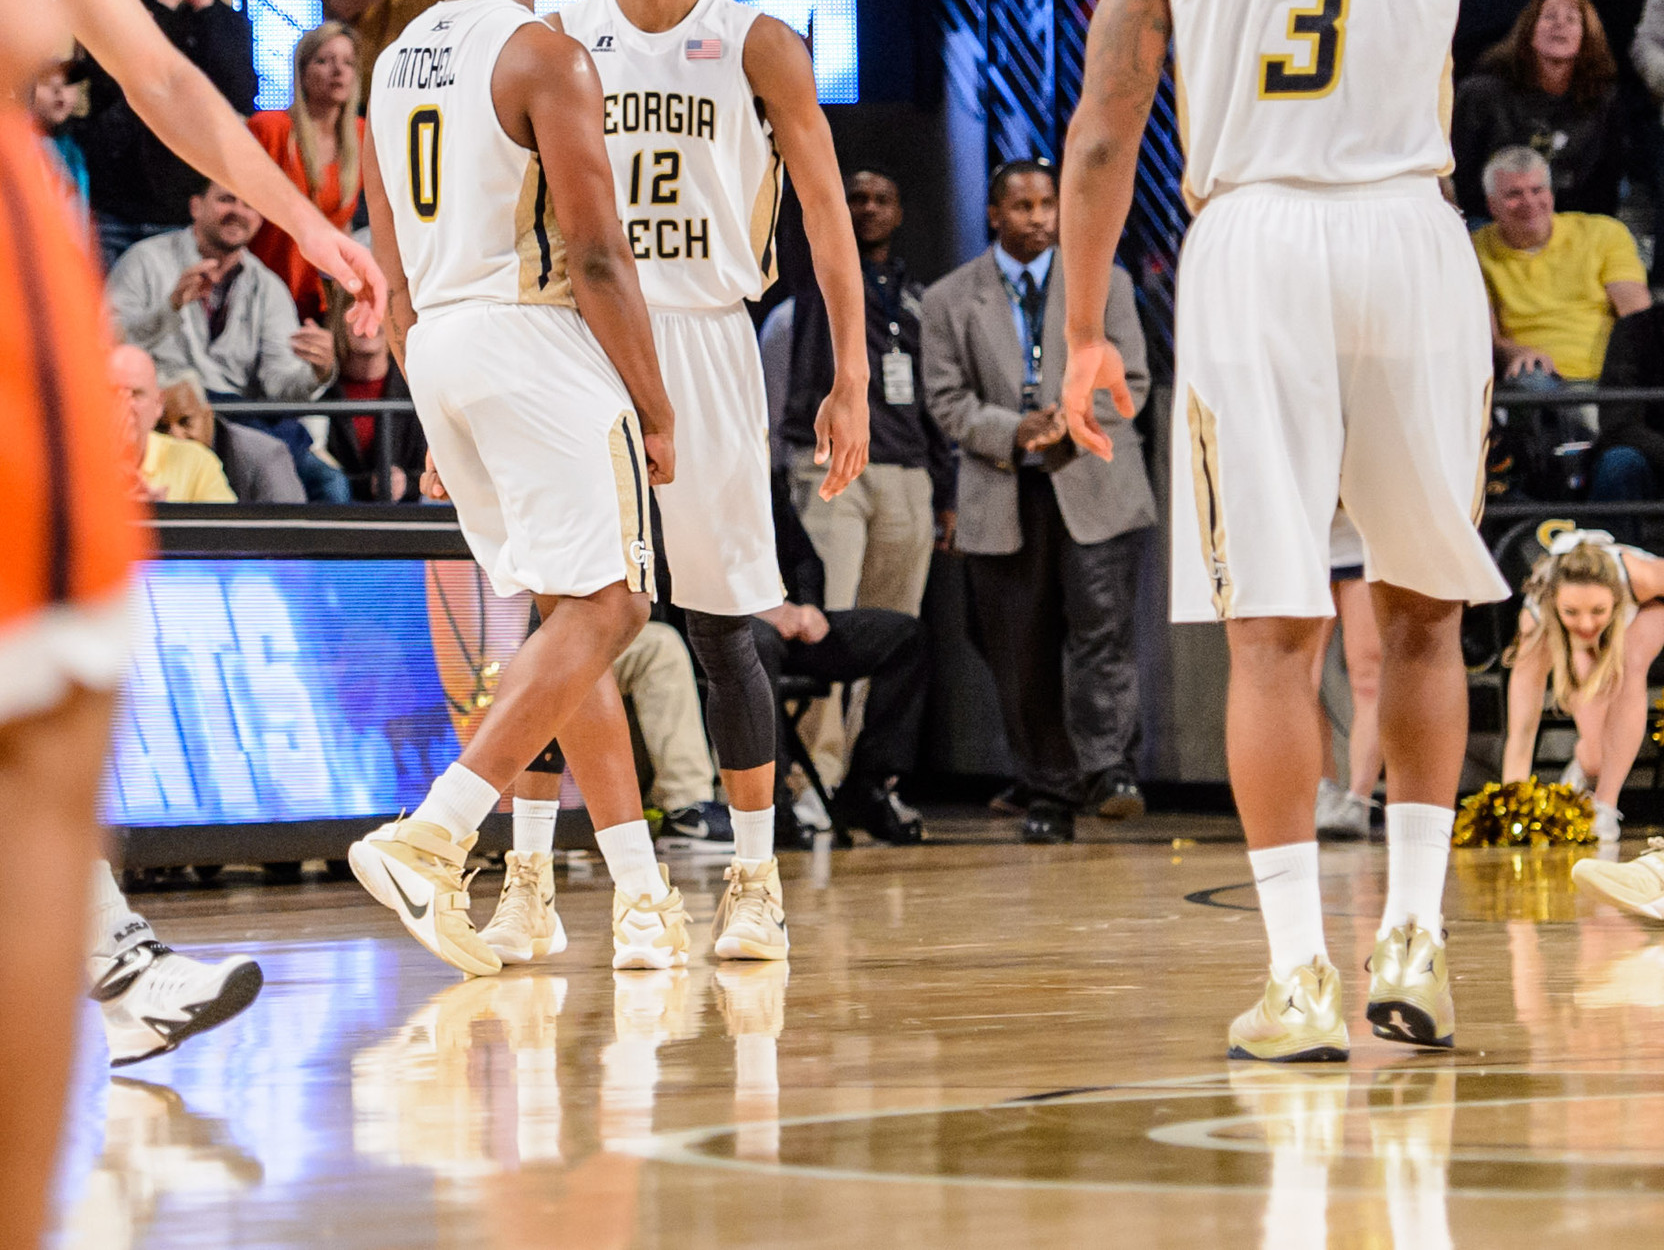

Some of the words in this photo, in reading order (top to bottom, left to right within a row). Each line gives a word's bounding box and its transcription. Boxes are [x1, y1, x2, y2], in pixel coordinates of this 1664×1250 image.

[604, 91, 716, 142] EORGIA
[407, 103, 444, 224] 0
[628, 148, 683, 207] 12
[620, 218, 710, 260] ECH
